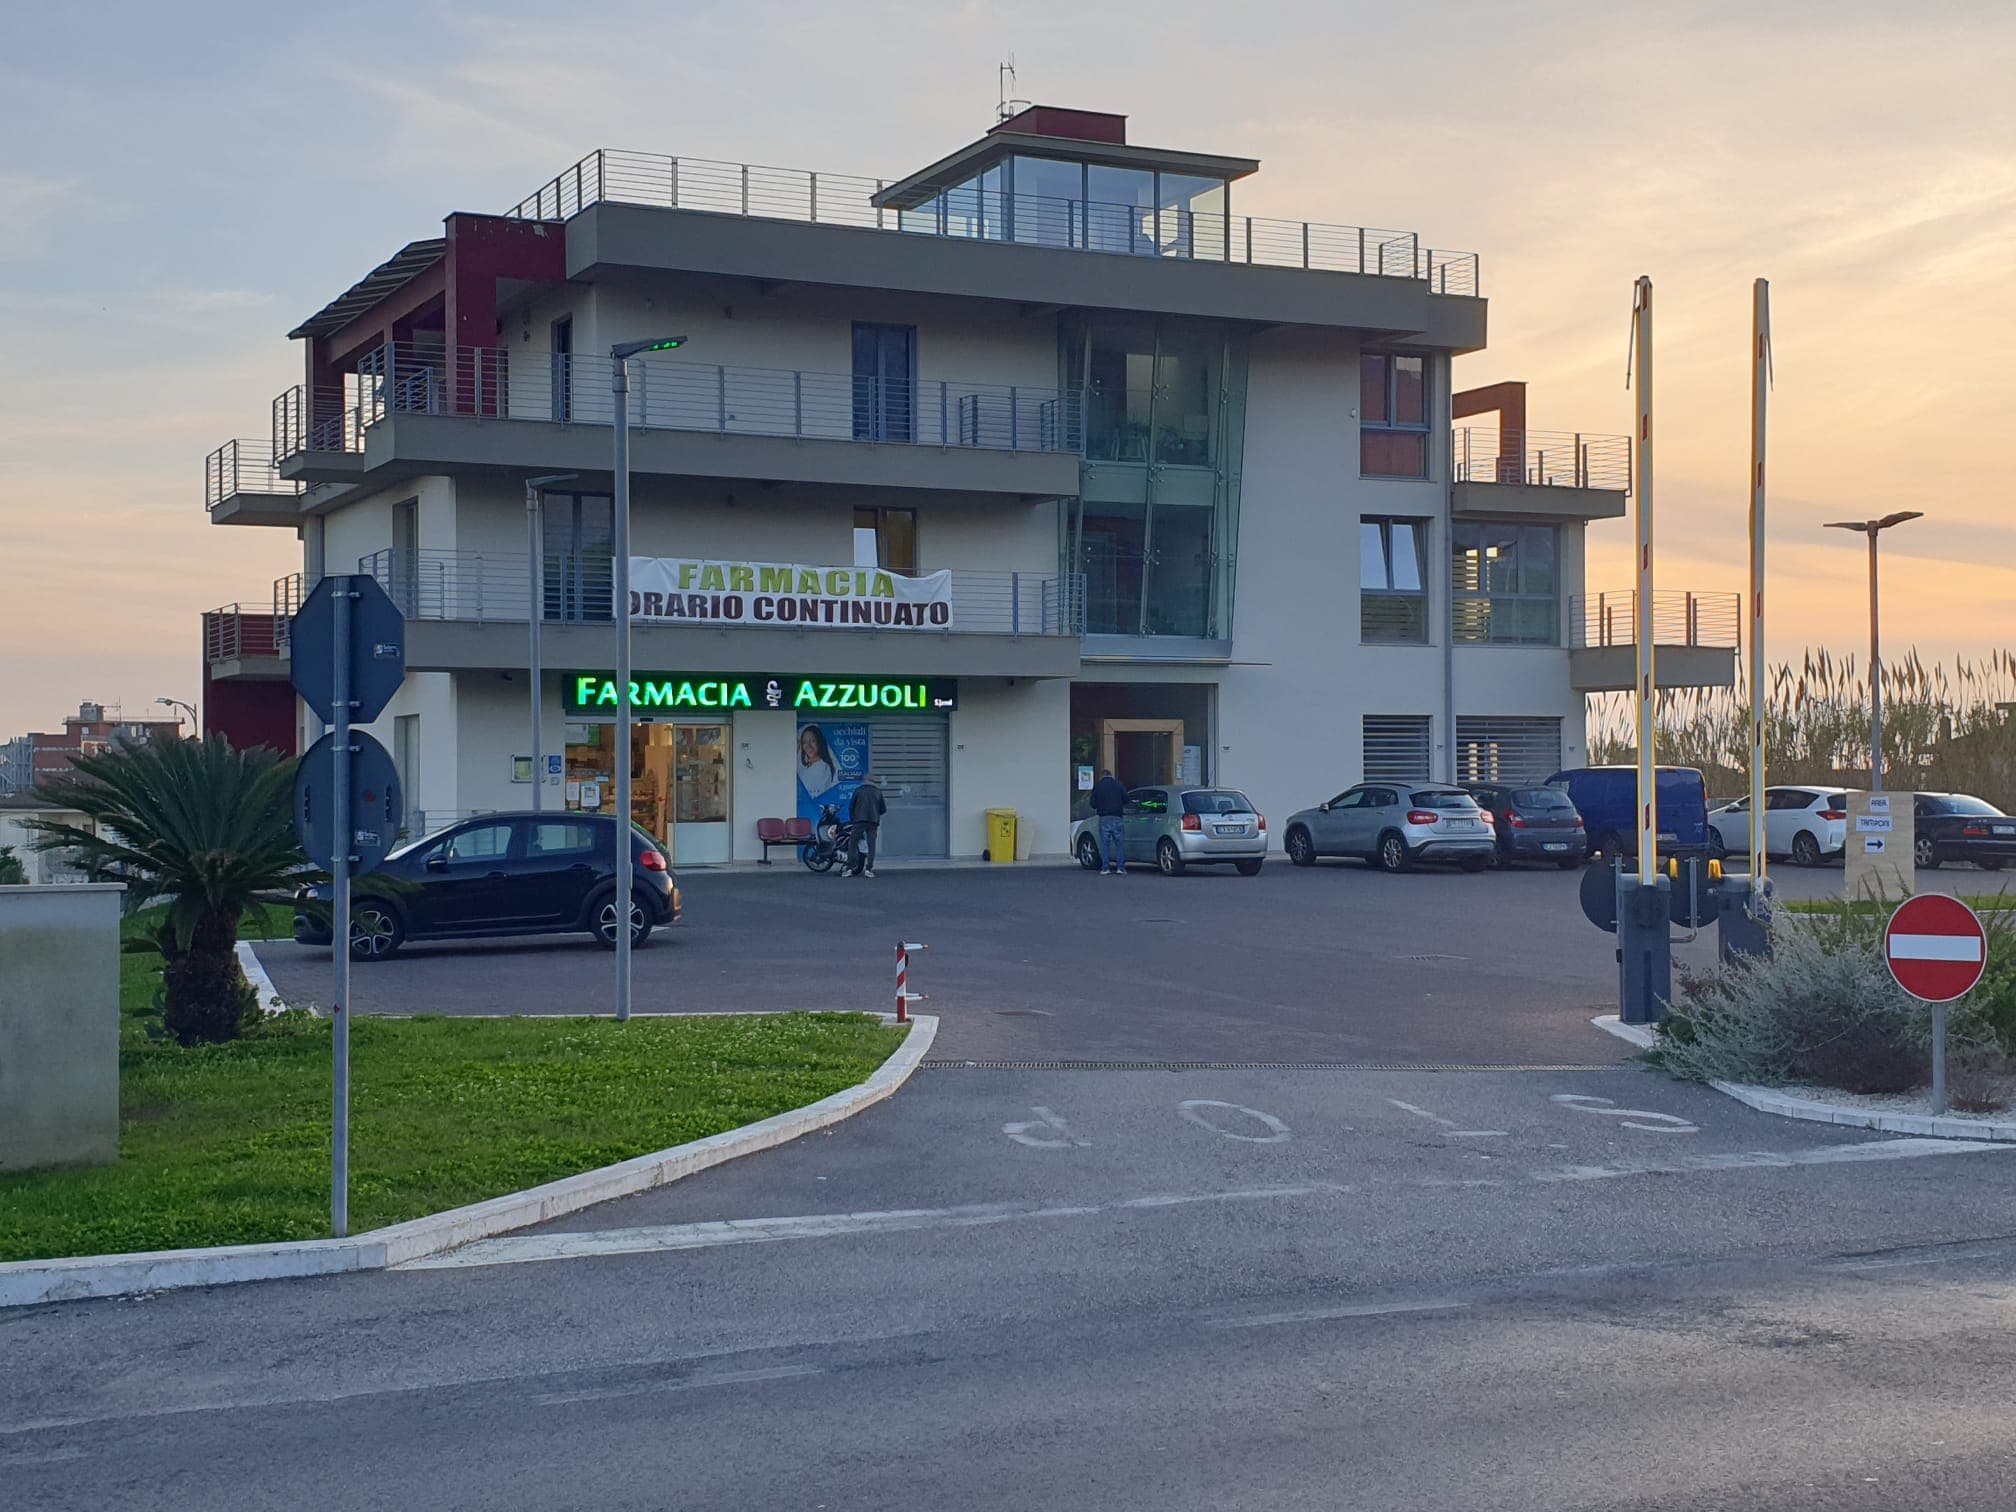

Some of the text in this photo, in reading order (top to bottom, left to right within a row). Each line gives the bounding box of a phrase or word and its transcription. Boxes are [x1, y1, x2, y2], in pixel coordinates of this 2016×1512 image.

[678, 562, 895, 598] FARMACIA
[753, 595, 949, 626] CONTINUATO
[576, 676, 927, 708] FARMACIA AZZUOLI
